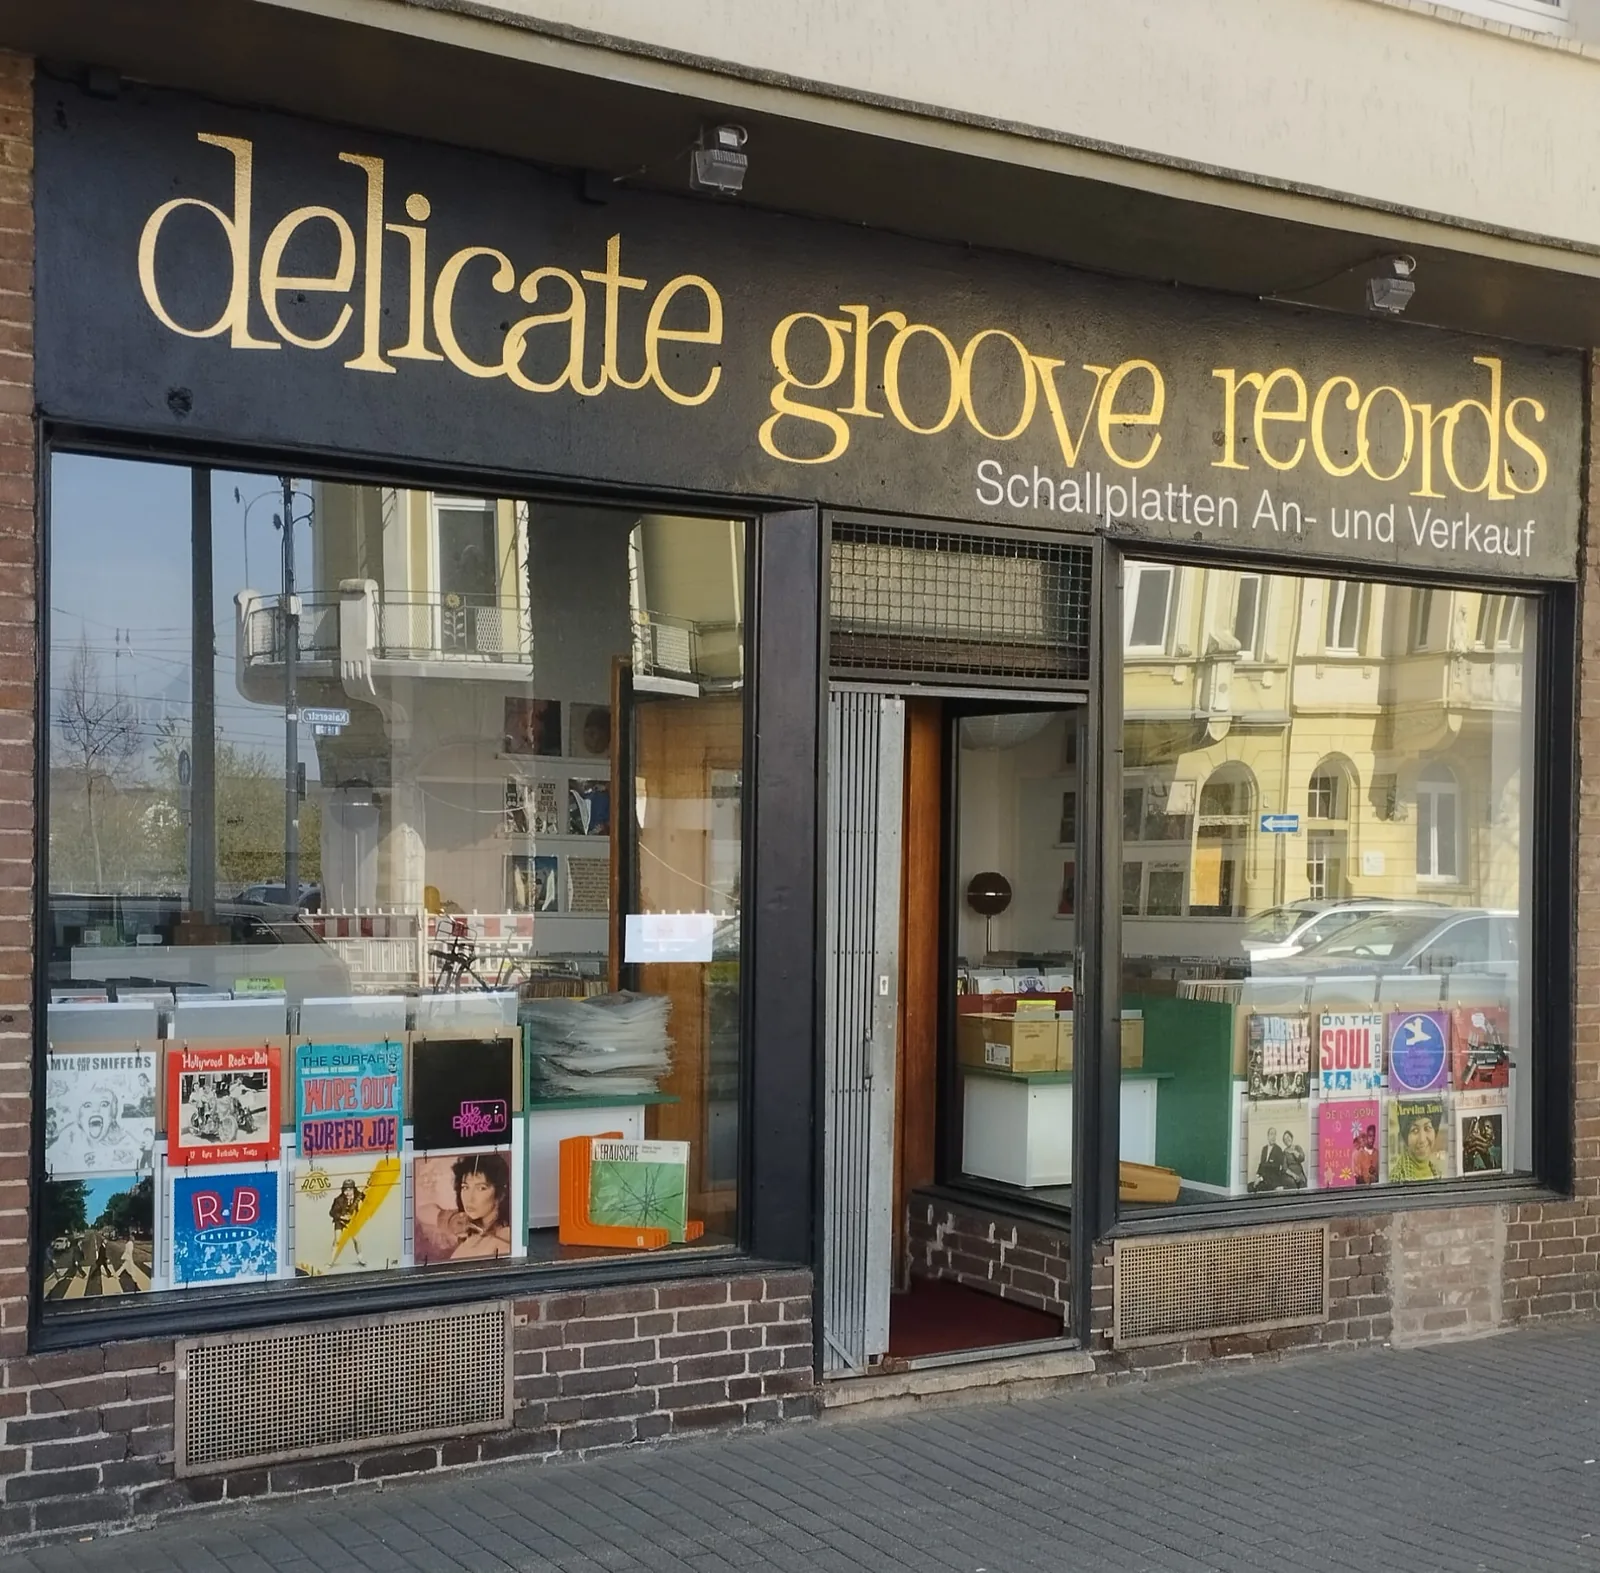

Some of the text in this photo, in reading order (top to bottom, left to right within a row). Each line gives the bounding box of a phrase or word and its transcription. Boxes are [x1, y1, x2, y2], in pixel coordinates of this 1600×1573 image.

[137, 132, 1548, 502] delicate groove records
[975, 458, 1537, 559] Schallplatten An- und Verkauf
[1322, 1015, 1382, 1026] ON THE
[92, 1056, 151, 1070] SNIFFERS
[182, 1053, 223, 1071] Hollywood
[301, 1053, 398, 1067] THE SURFARIS
[1321, 1028, 1372, 1071] SOUL
[304, 1076, 397, 1115] WIPE OUT
[303, 1117, 395, 1151] SURFER JOE
